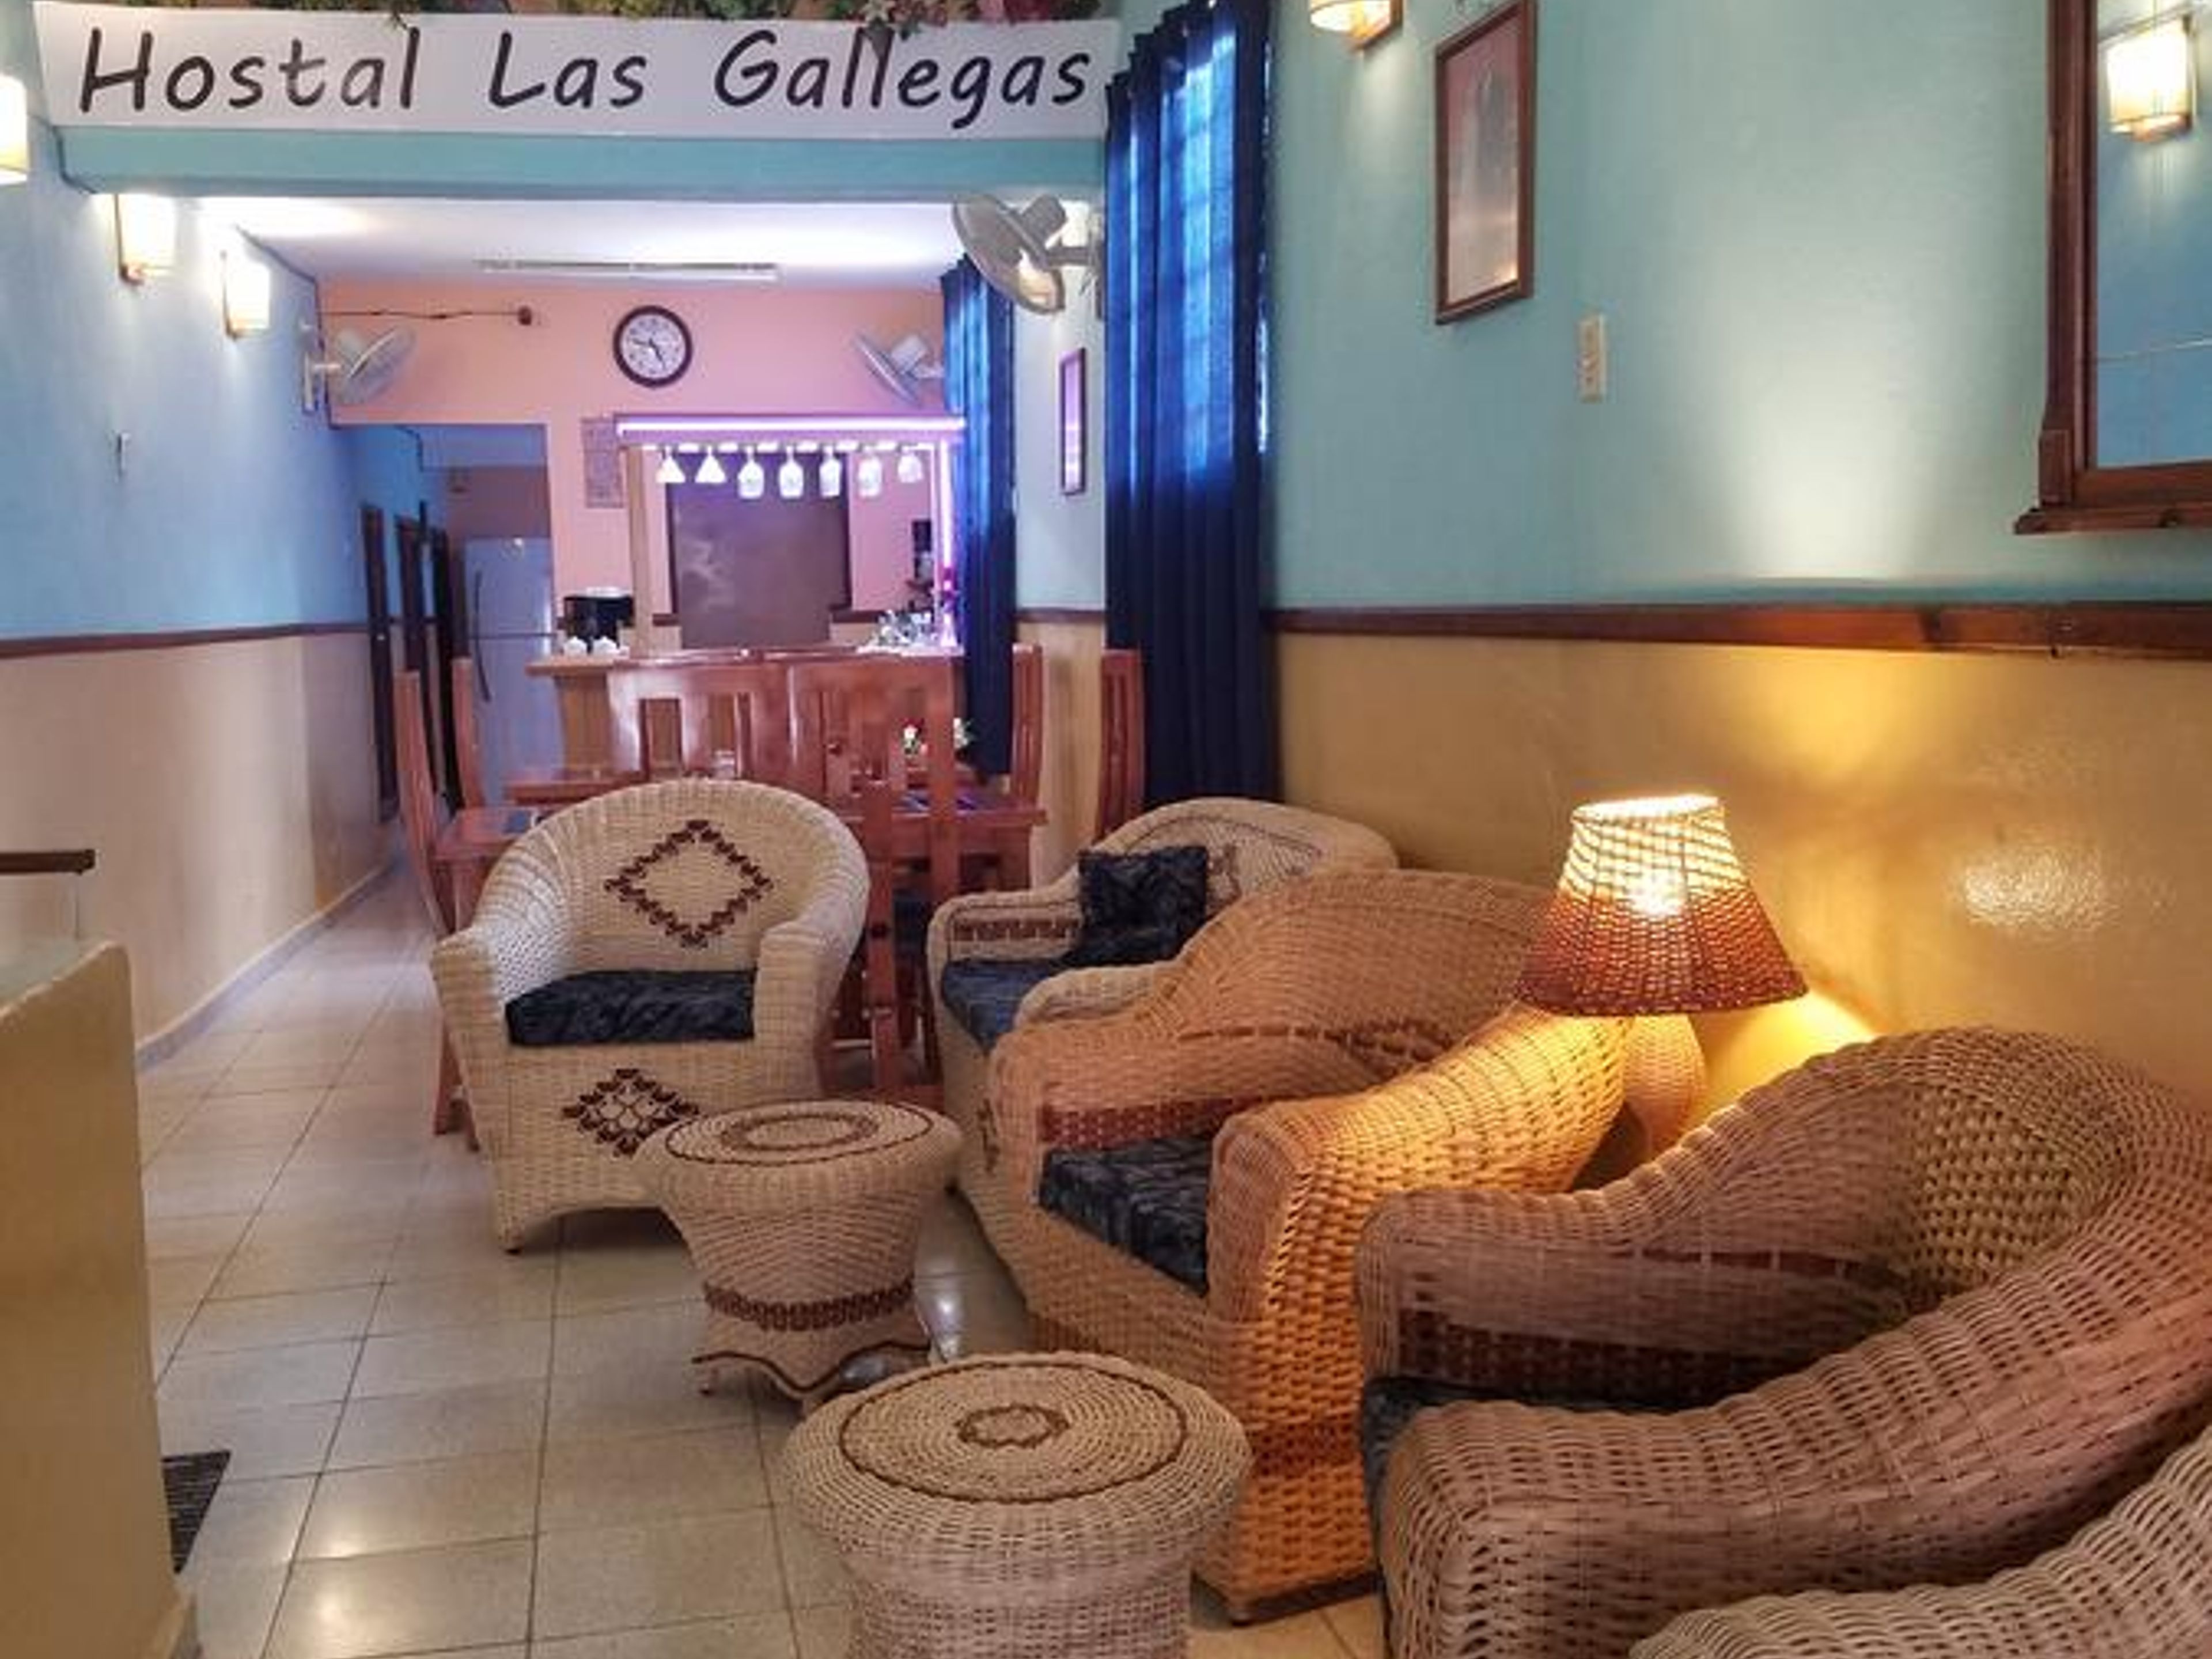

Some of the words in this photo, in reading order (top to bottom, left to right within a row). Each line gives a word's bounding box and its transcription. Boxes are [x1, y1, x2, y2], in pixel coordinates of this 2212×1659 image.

[79, 26, 421, 113] Hostal
[488, 31, 647, 109] Las
[714, 26, 1092, 130] Gallegas
